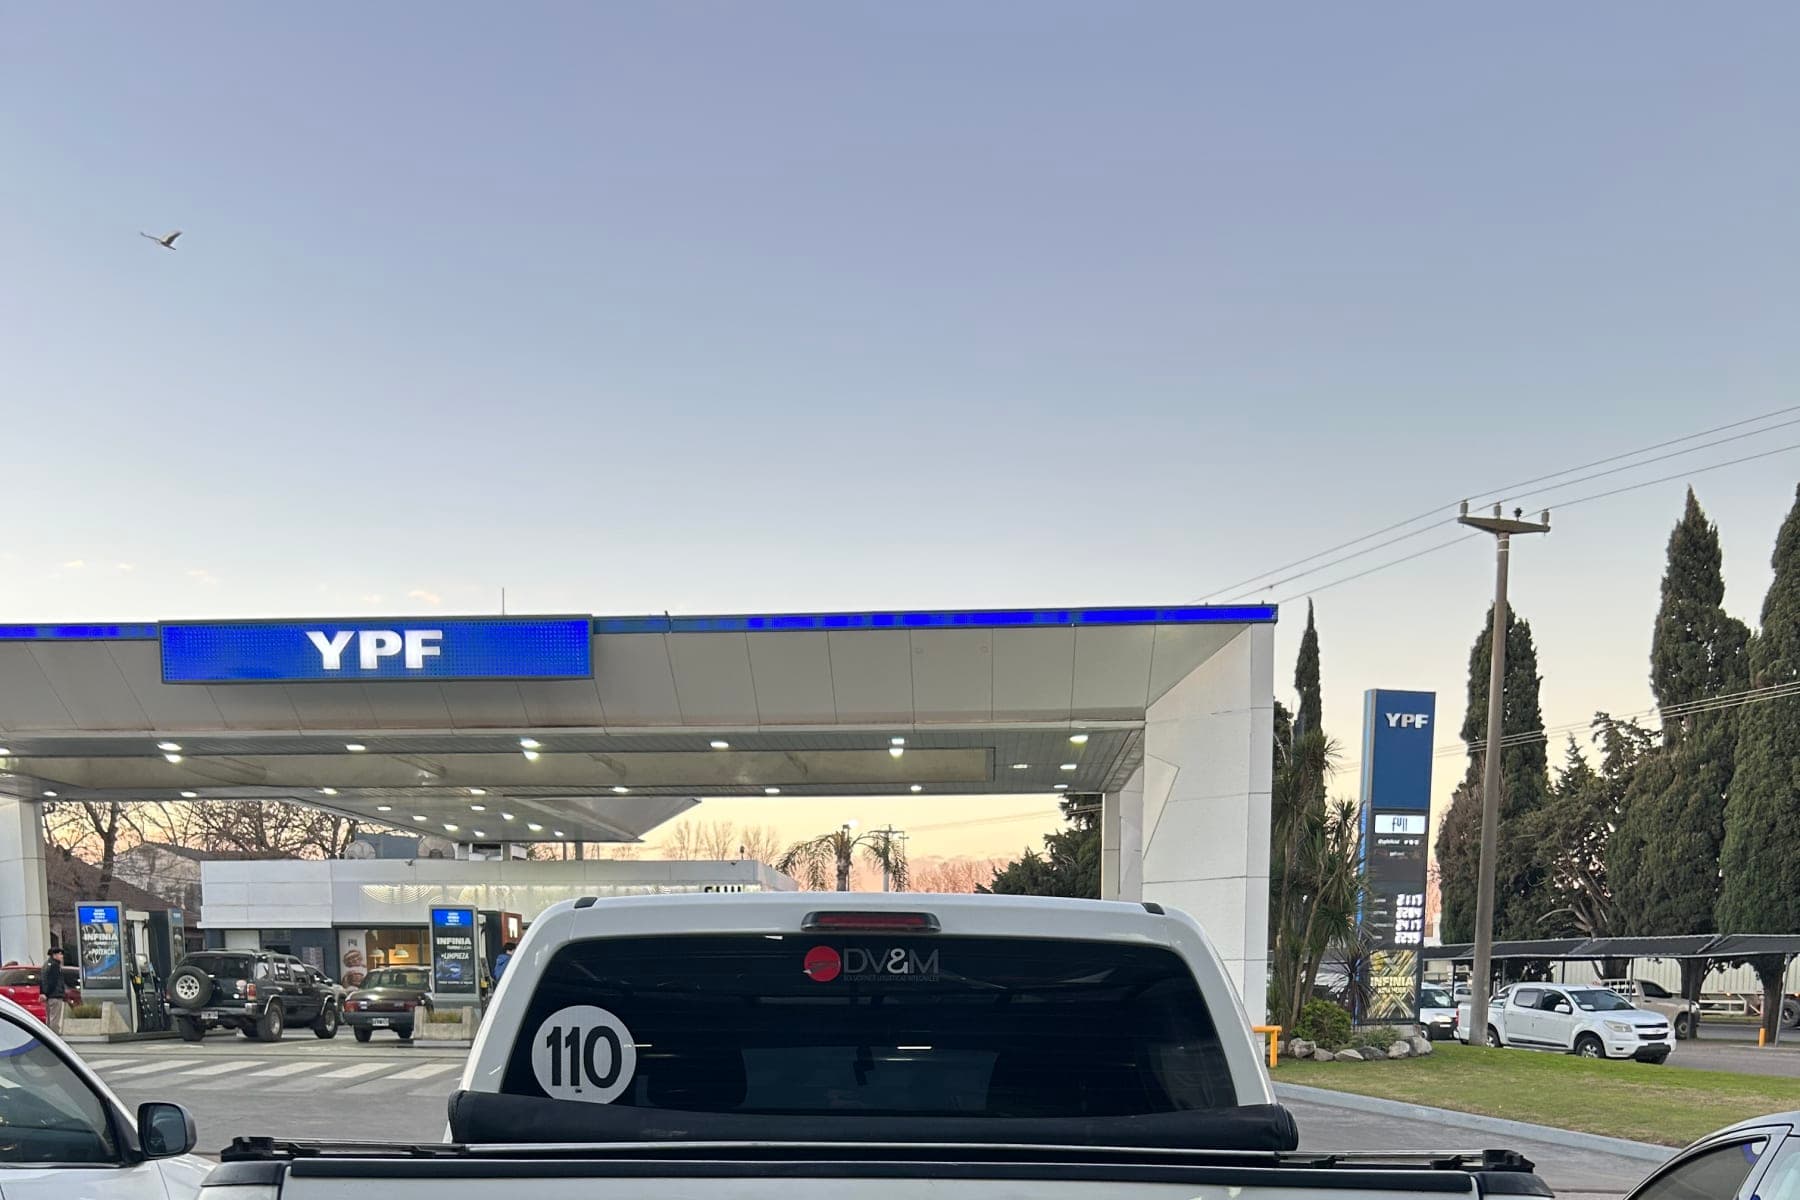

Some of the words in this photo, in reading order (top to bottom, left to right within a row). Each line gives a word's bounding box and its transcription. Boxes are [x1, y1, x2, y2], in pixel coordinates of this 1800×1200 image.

[305, 629, 443, 670] YPF
[1385, 712, 1429, 729] YPF
[83, 933, 118, 941] INFINIA
[436, 937, 472, 945] INFINIA
[844, 948, 940, 974] DV&M
[1370, 976, 1414, 987] INFINIA
[546, 1025, 622, 1089] 110
